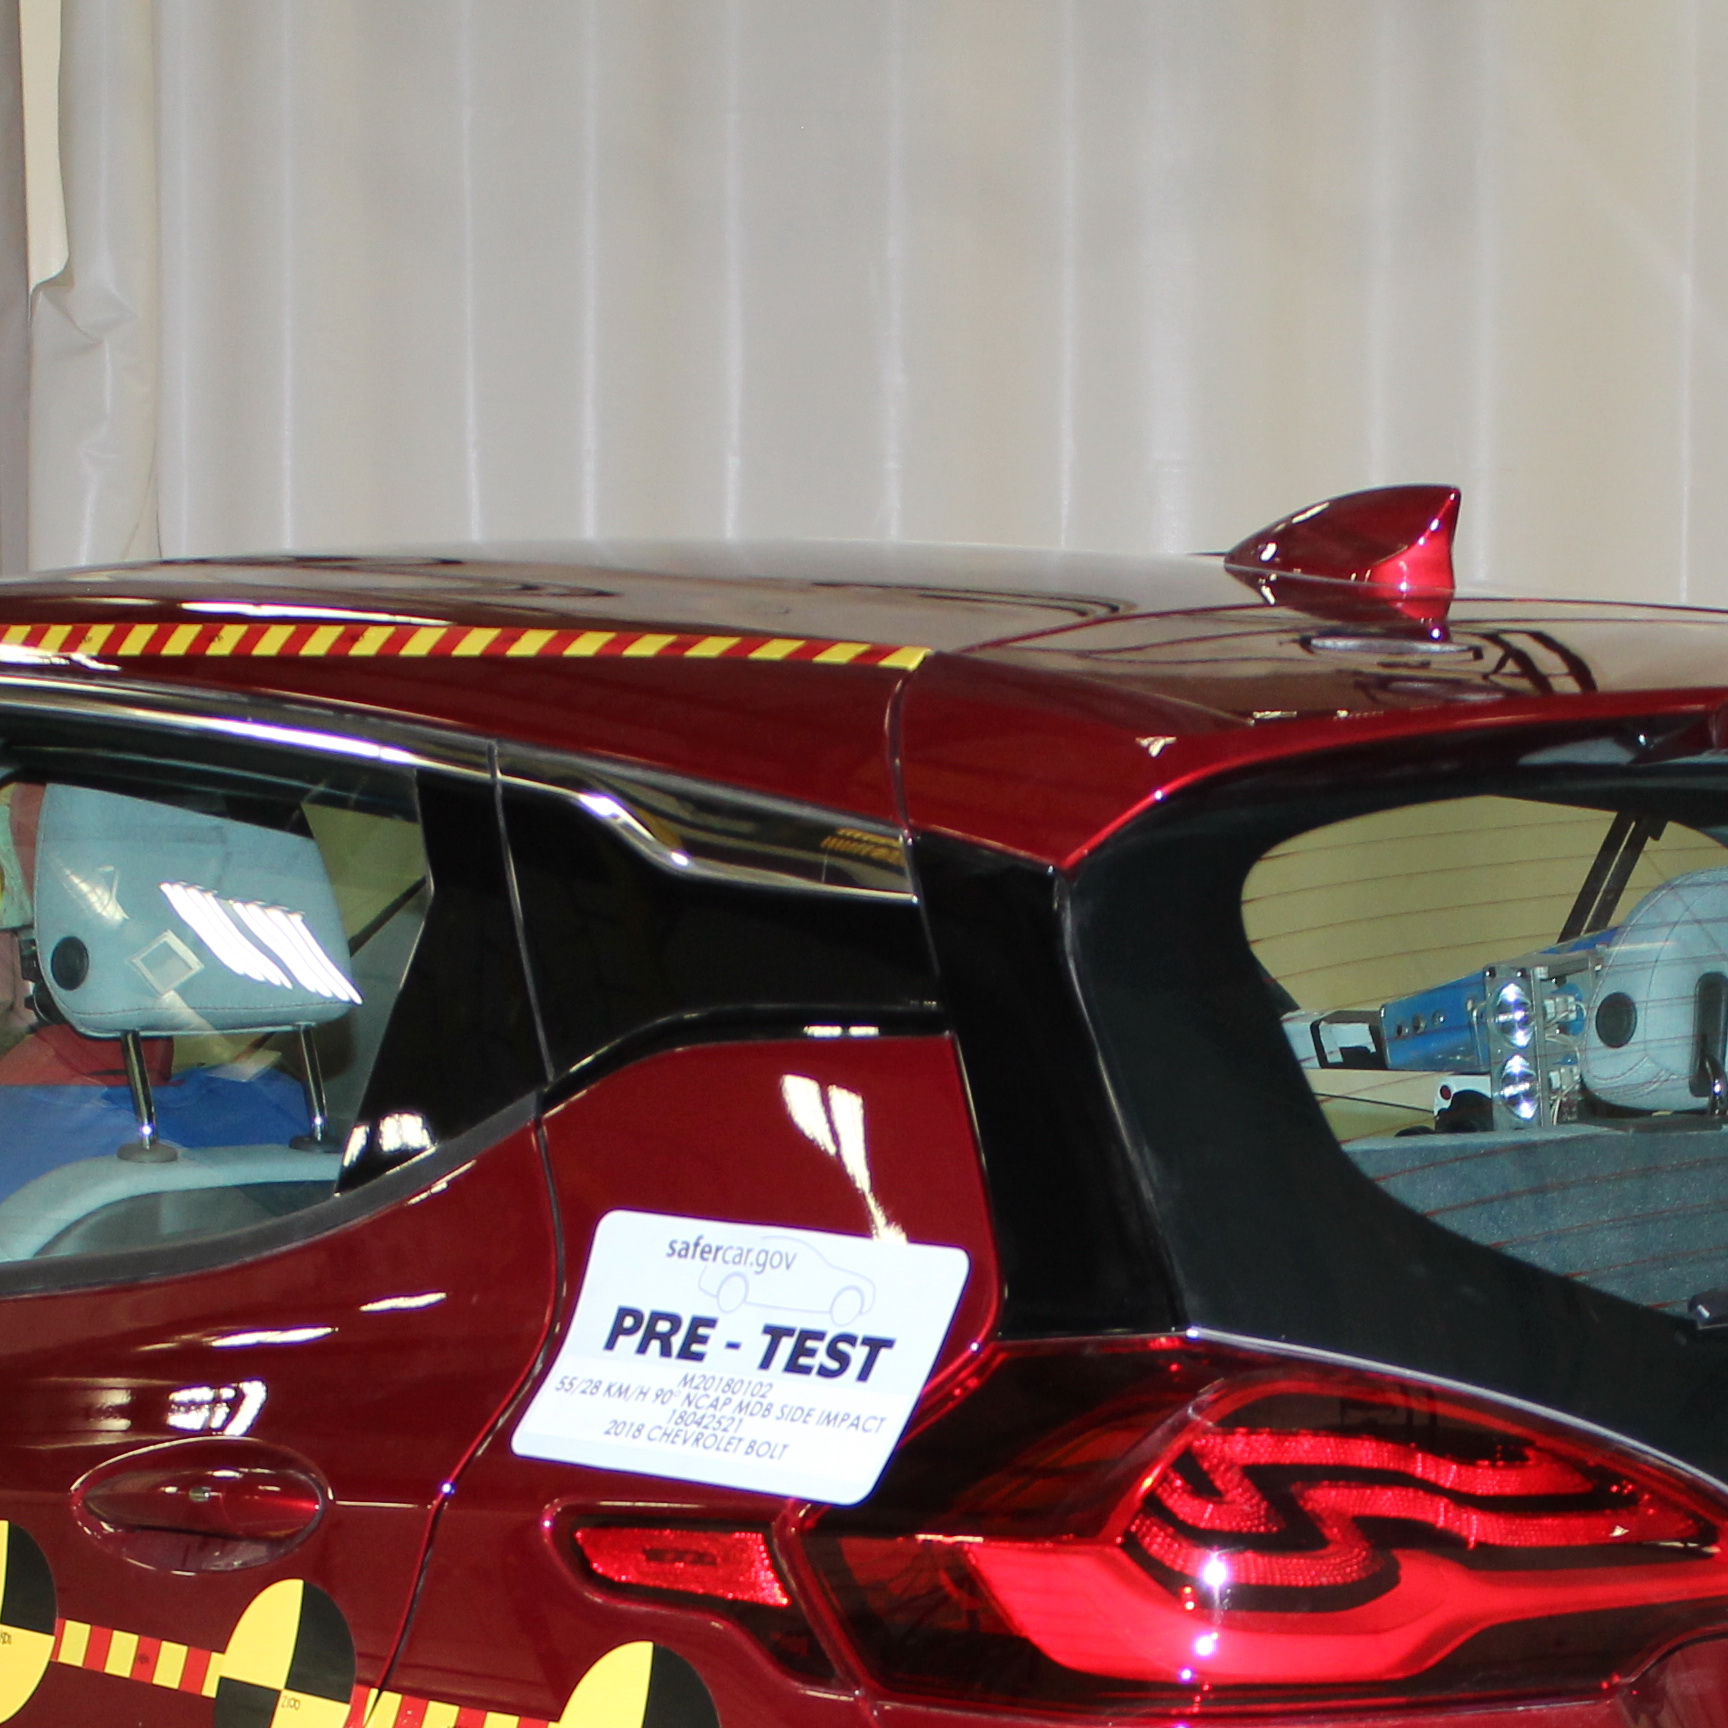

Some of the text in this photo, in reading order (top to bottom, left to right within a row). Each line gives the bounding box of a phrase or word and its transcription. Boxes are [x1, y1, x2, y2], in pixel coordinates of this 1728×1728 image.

[665, 1233, 797, 1276] safercar.gov
[602, 1304, 719, 1363] PRE
[757, 1322, 897, 1383] TEST
[554, 1375, 603, 1397] 55/28
[603, 1381, 651, 1403] KM/H
[681, 1391, 733, 1414] NCAP
[732, 1398, 775, 1419] MDB
[775, 1403, 816, 1425] SIDE
[815, 1409, 888, 1435] IMPACT
[678, 1372, 774, 1399] M20180102
[603, 1419, 790, 1461] 2018 CHEVROLET BOLT
[668, 1408, 743, 1434] 18042521
